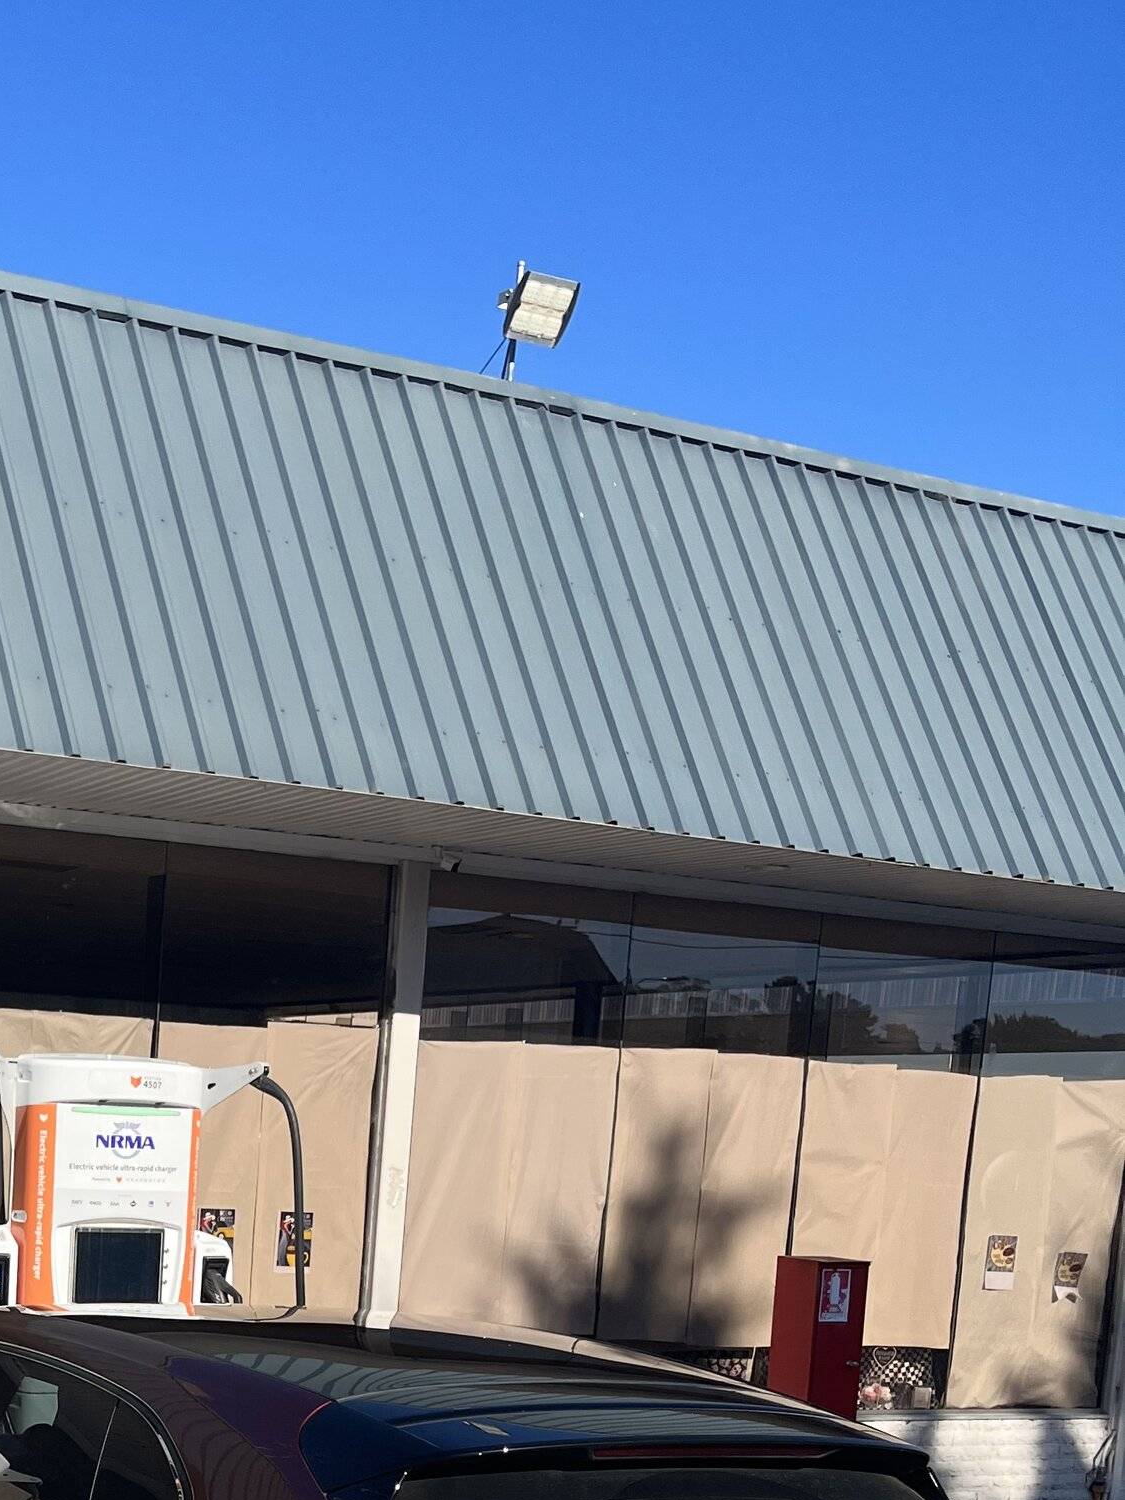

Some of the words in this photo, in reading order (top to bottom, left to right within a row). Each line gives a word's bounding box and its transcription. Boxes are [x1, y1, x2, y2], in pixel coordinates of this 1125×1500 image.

[143, 1080, 162, 1089] 4507
[38, 1130, 48, 1163] Electric
[96, 1134, 155, 1150] NRMA
[37, 1164, 47, 1196] vehicle
[68, 1163, 94, 1171] Electric
[95, 1164, 118, 1172] vehicle
[120, 1164, 153, 1173] ultra-rapid
[154, 1165, 177, 1174] charger
[35, 1197, 46, 1245] ultra-rapid
[33, 1246, 43, 1280] charger
